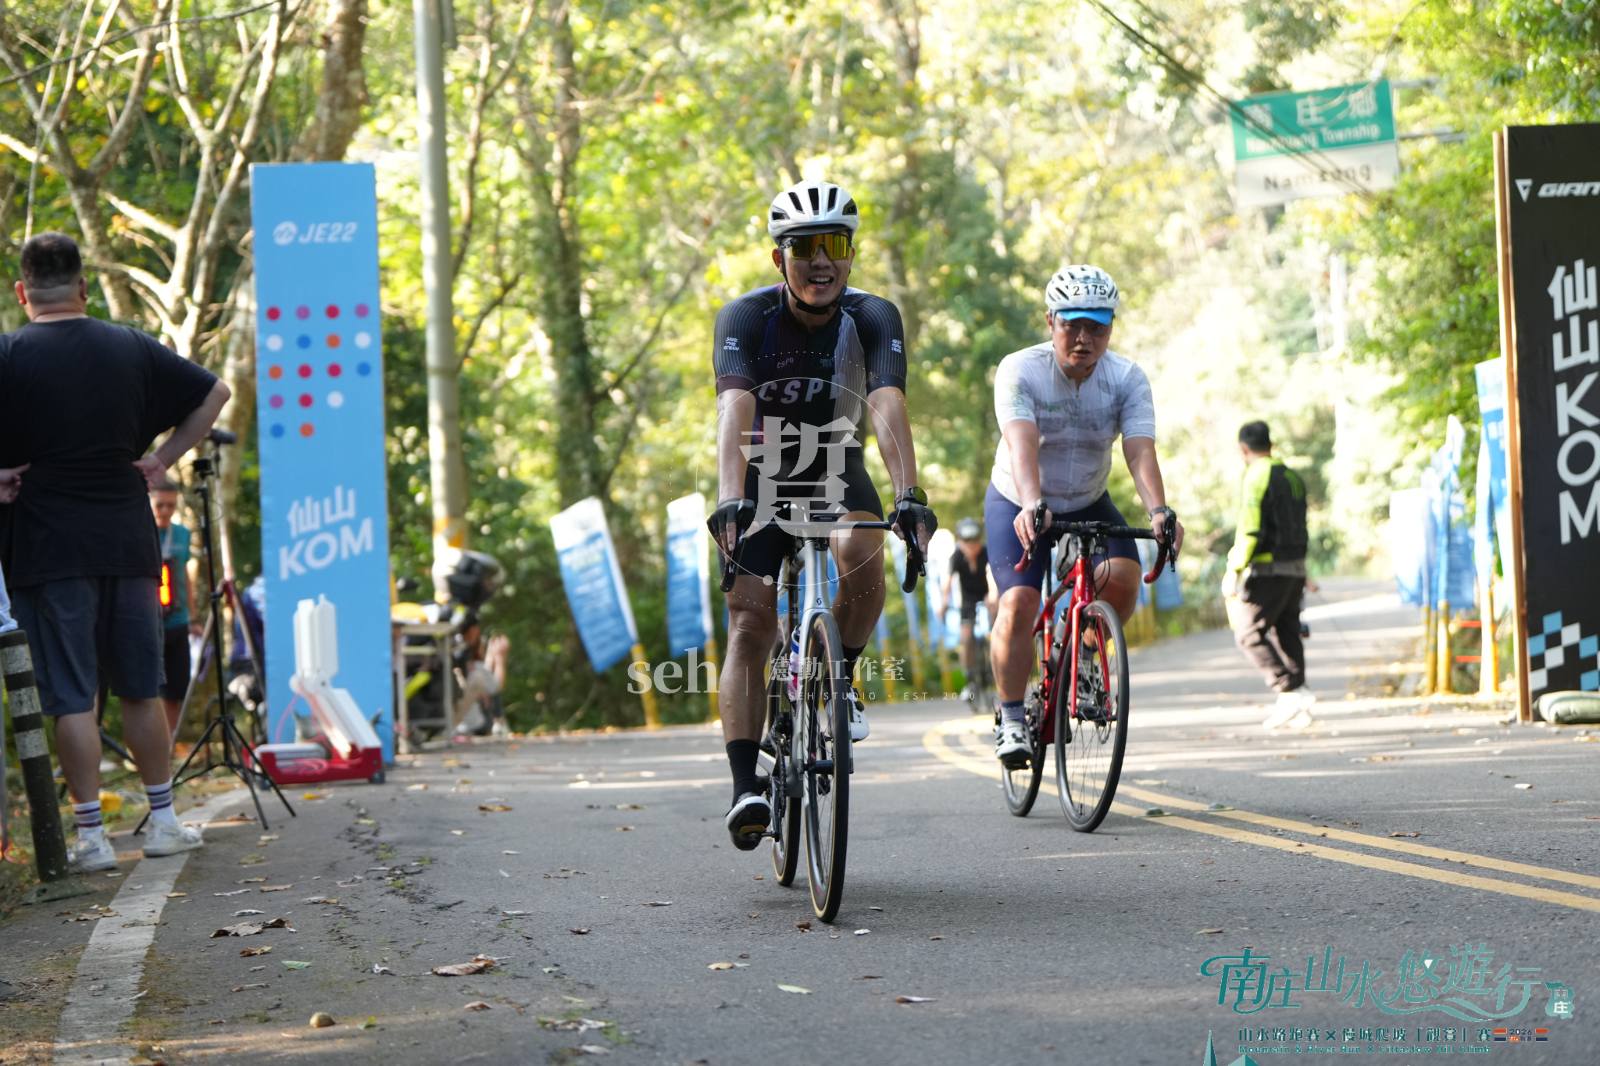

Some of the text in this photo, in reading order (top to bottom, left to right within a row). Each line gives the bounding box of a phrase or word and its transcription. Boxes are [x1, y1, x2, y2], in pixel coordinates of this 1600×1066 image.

[1320, 123, 1381, 144] Township
[298, 222, 358, 242] JE22
[1073, 284, 1107, 296] 2175
[1547, 258, 1600, 545] 仙山 KOM
[287, 485, 356, 539] 仙山
[279, 516, 374, 581] KOM
